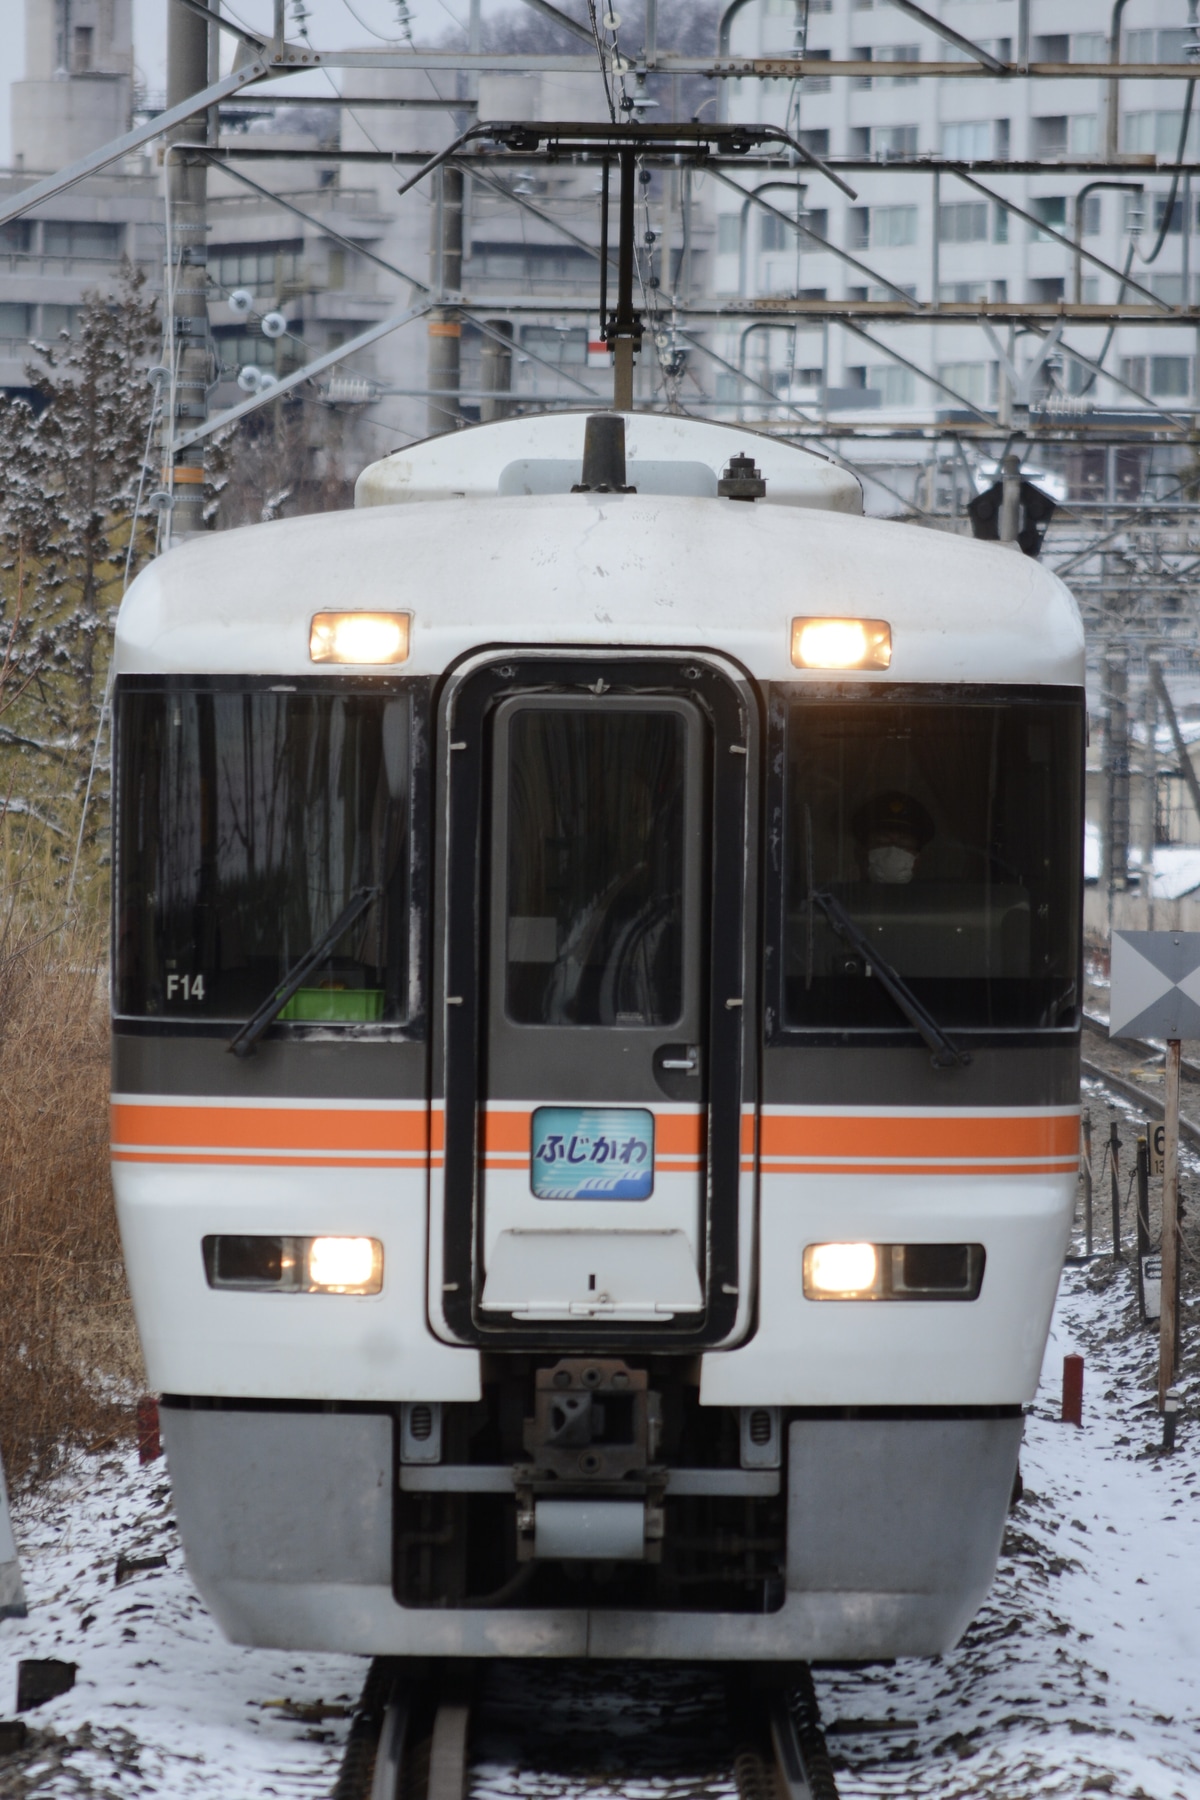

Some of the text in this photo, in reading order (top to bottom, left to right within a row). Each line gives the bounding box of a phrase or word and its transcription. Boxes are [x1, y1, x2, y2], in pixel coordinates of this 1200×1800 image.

[167, 974, 205, 1000] F14
[535, 1136, 647, 1164] ふじかわ
